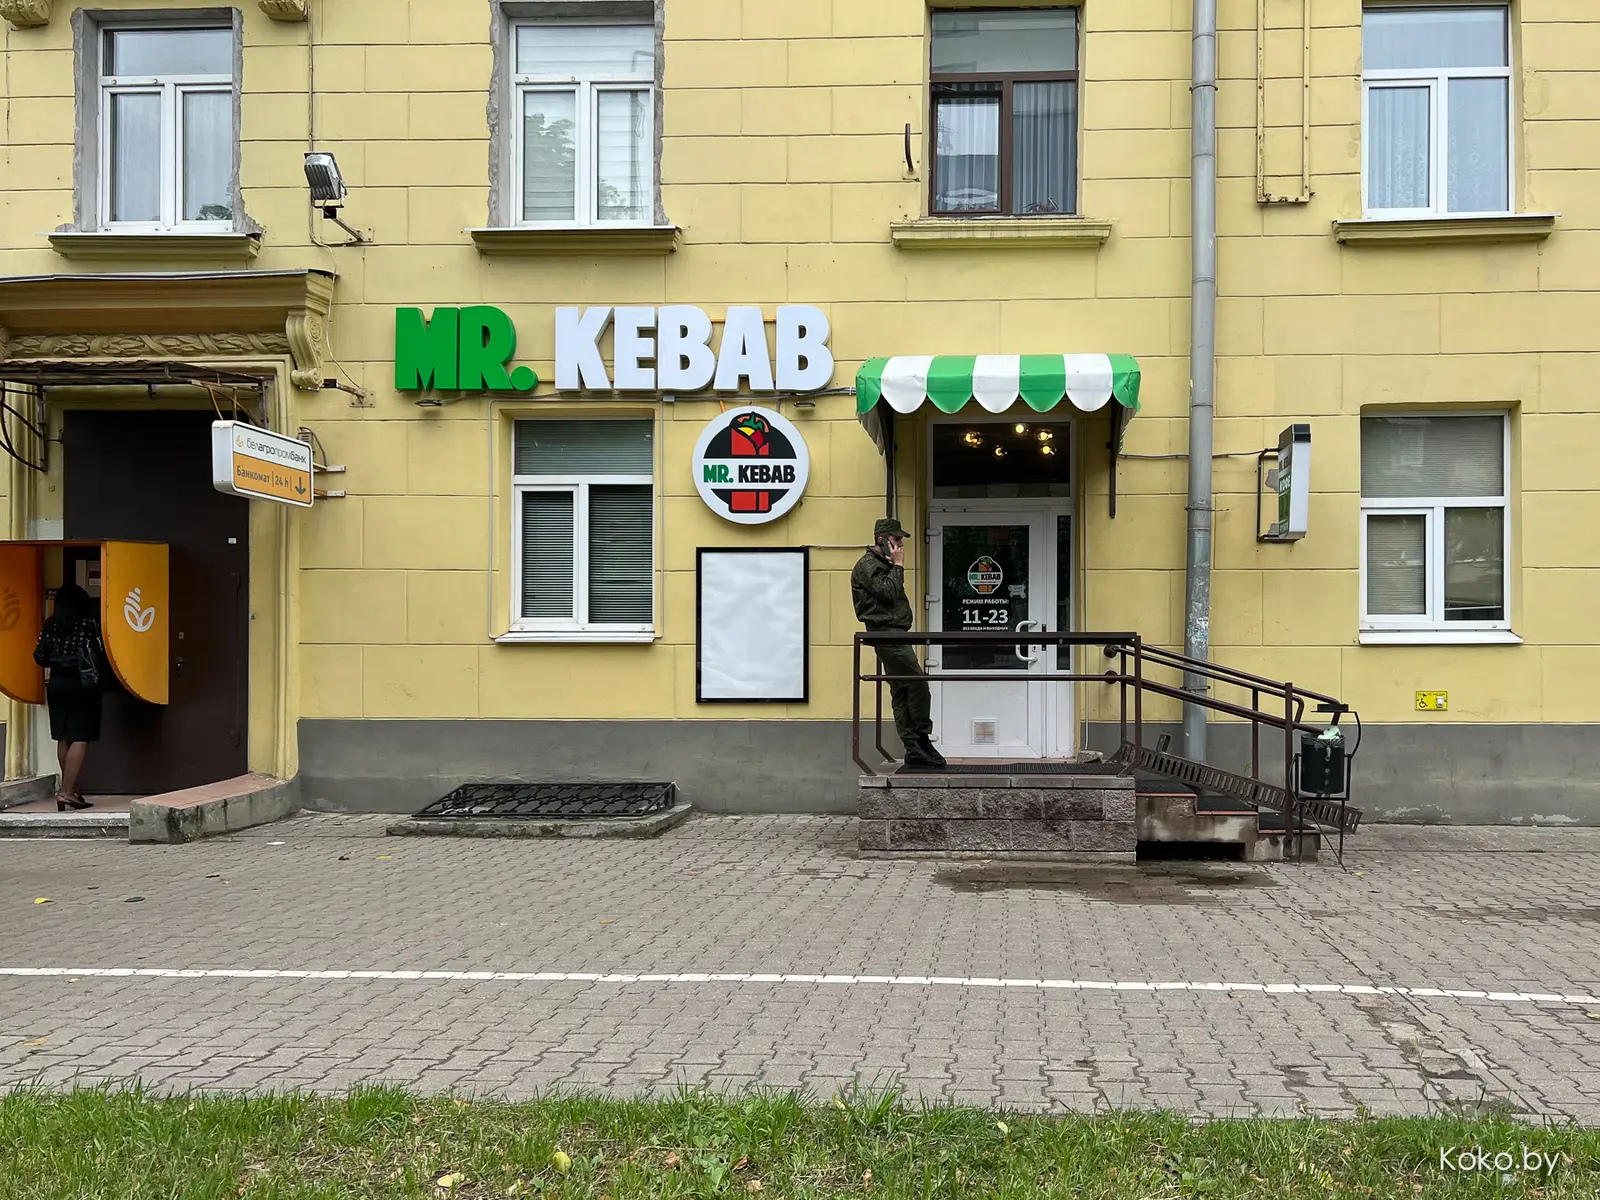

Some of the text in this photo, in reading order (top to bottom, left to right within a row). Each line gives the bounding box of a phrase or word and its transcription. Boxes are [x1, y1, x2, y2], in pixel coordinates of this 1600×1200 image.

[395, 305, 835, 391] MR. KEBAB
[236, 465, 270, 483] Банкомат
[703, 464, 796, 483] MR. KEBAB
[962, 609, 1009, 624] 11-23
